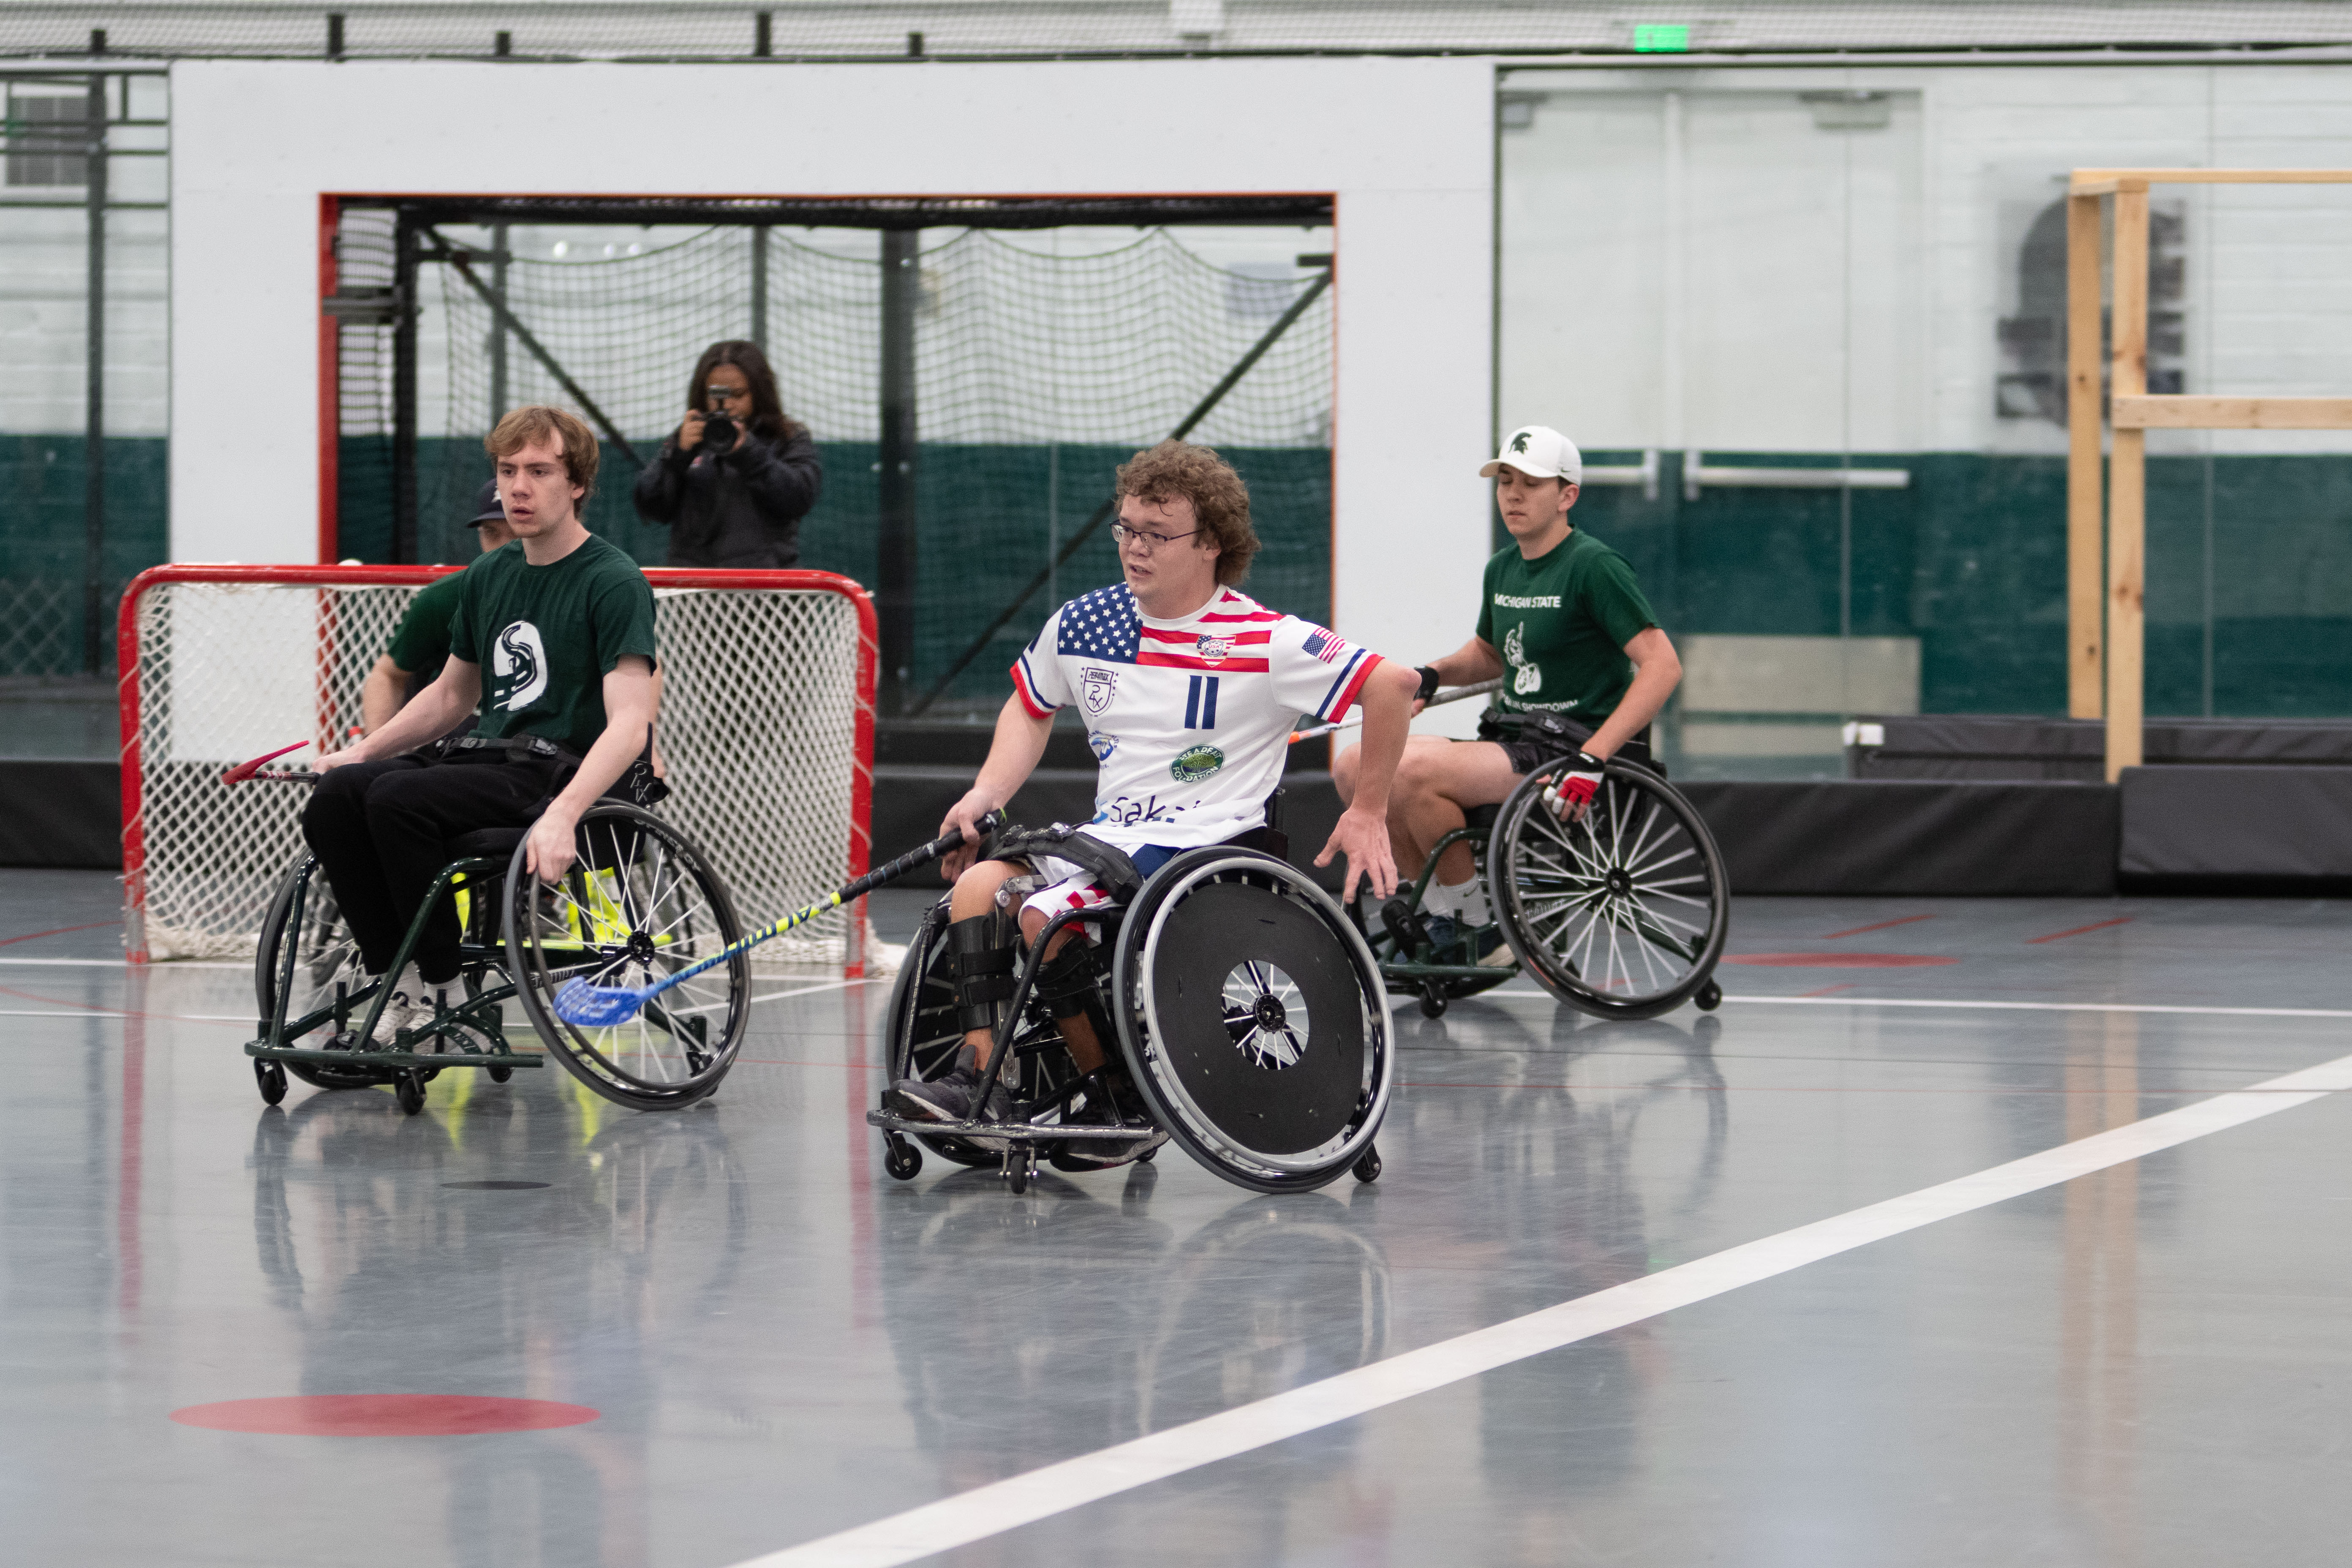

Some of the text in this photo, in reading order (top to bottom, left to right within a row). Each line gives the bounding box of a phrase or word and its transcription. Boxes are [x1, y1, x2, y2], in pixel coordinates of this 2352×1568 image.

[1494, 593, 1561, 608] MICHIGAN STATE
[1184, 675, 1219, 730] 11
